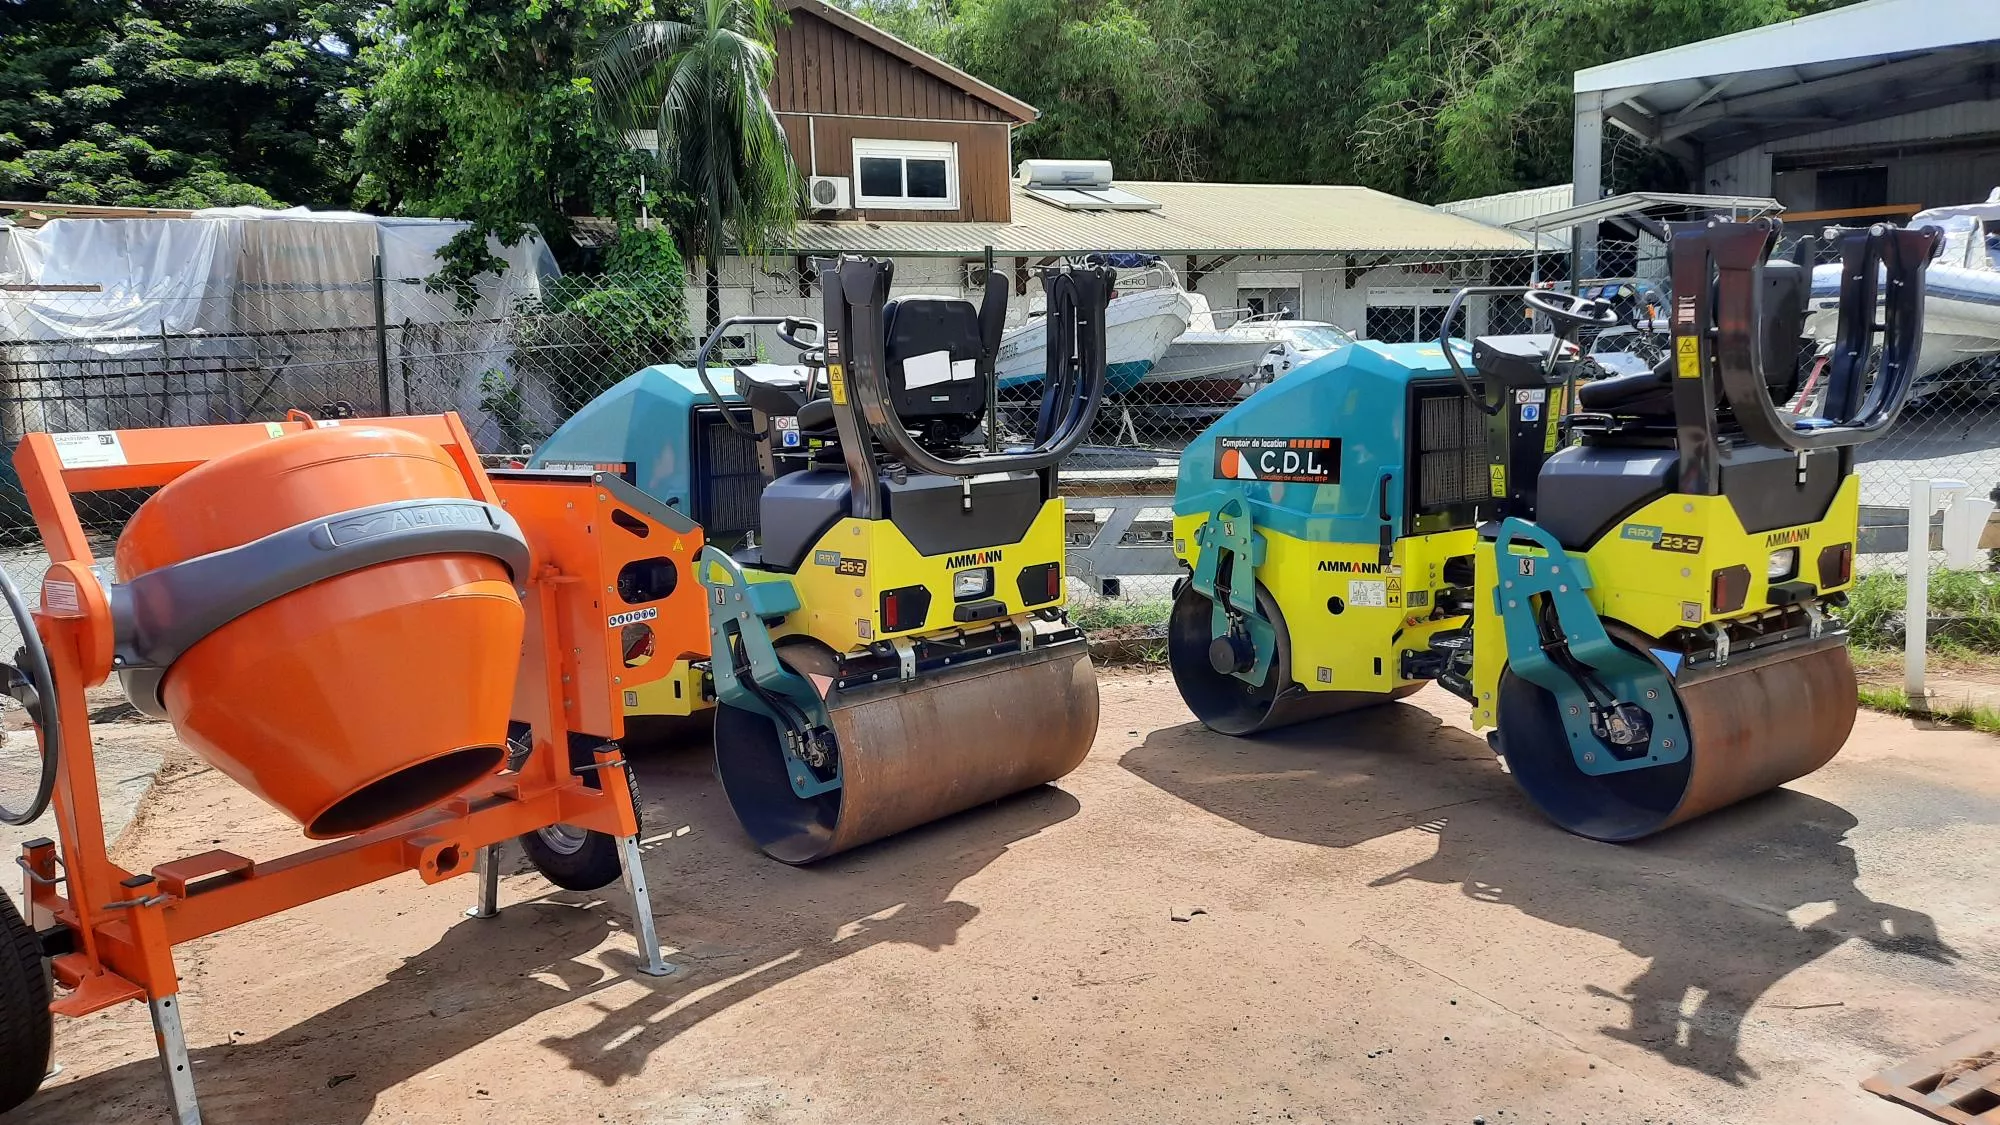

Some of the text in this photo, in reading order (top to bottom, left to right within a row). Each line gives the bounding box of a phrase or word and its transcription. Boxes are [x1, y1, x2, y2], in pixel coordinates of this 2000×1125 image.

[99, 435, 112, 445] 97
[1222, 438, 1287, 449] Comptoir de location
[1260, 450, 1328, 475] C.D.L.
[391, 505, 483, 531] ALTRAD
[1628, 527, 1699, 550] ARX 23-2
[1765, 527, 1810, 548] AMMANN
[818, 553, 865, 574] ARX 26-2
[945, 549, 1002, 570] AMMANN
[1318, 560, 1381, 574] AMMANN
